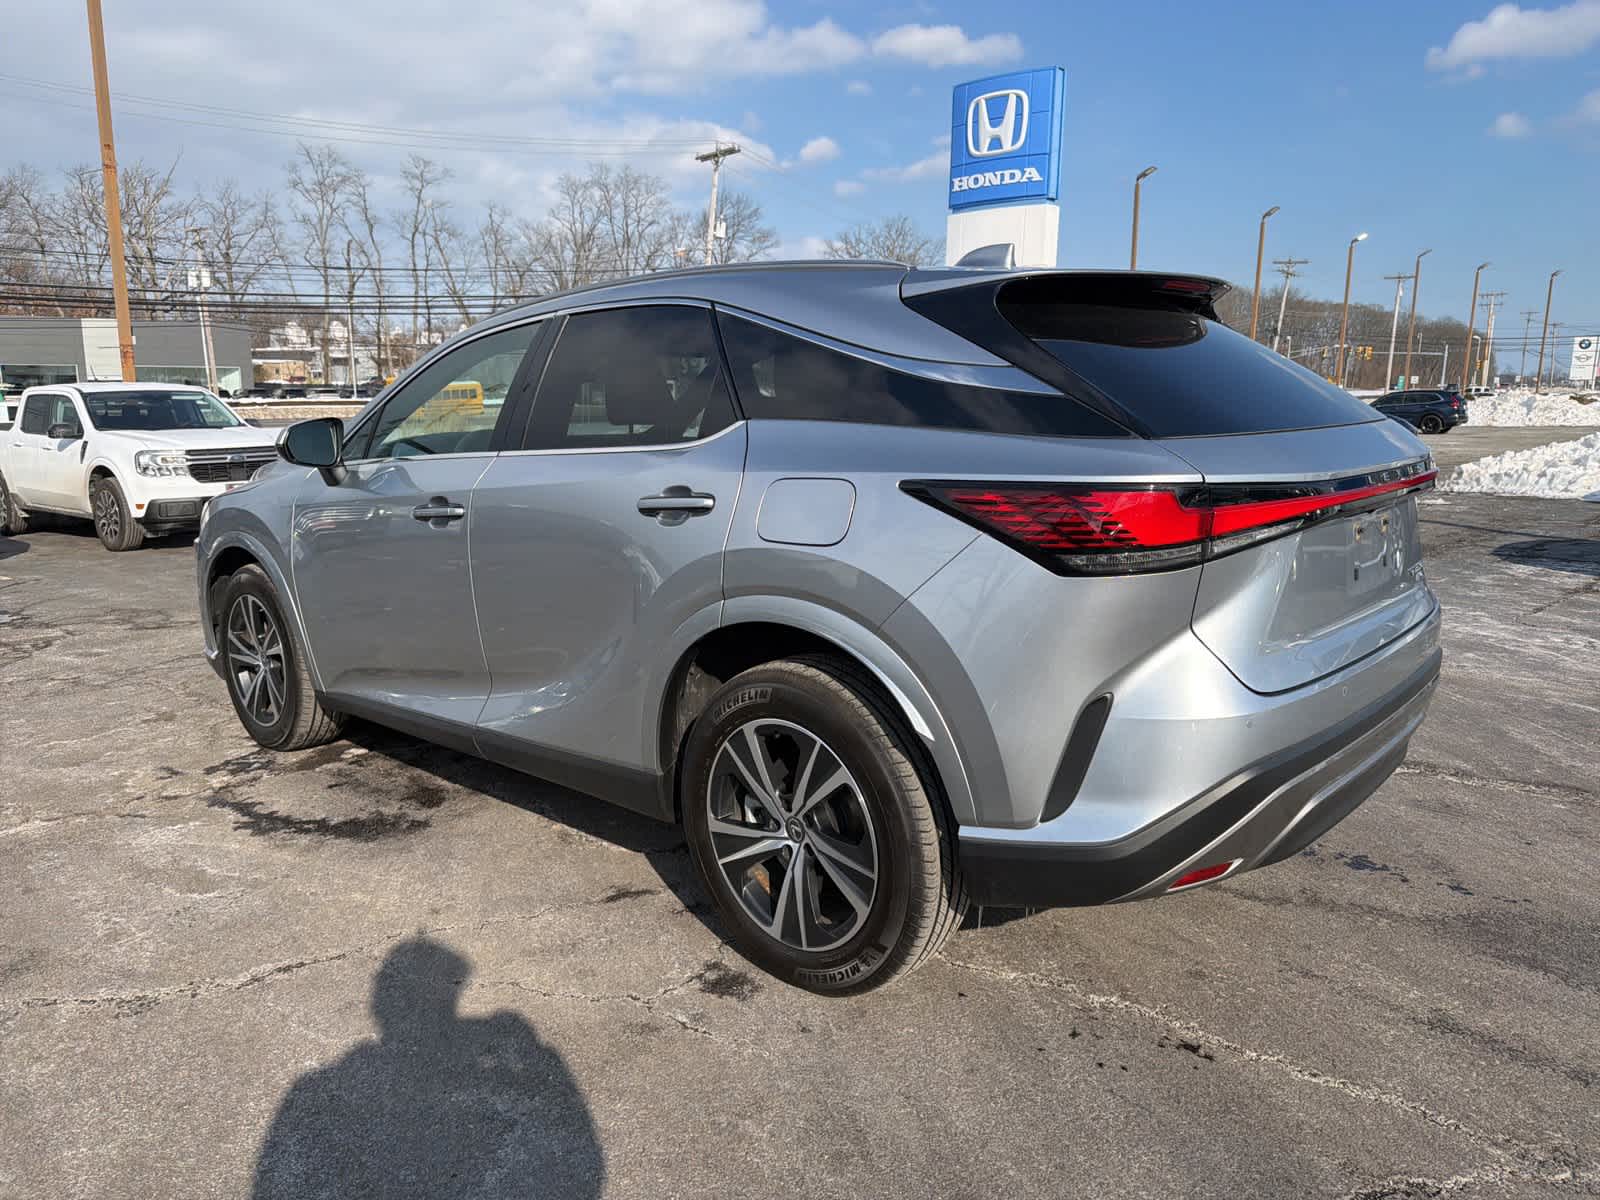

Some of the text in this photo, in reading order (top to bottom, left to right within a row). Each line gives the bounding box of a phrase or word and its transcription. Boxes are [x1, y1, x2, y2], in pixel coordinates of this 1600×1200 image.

[952, 167, 1043, 192] HONDA
[713, 689, 770, 722] MICHELIN
[799, 962, 861, 985] MICHELIN
